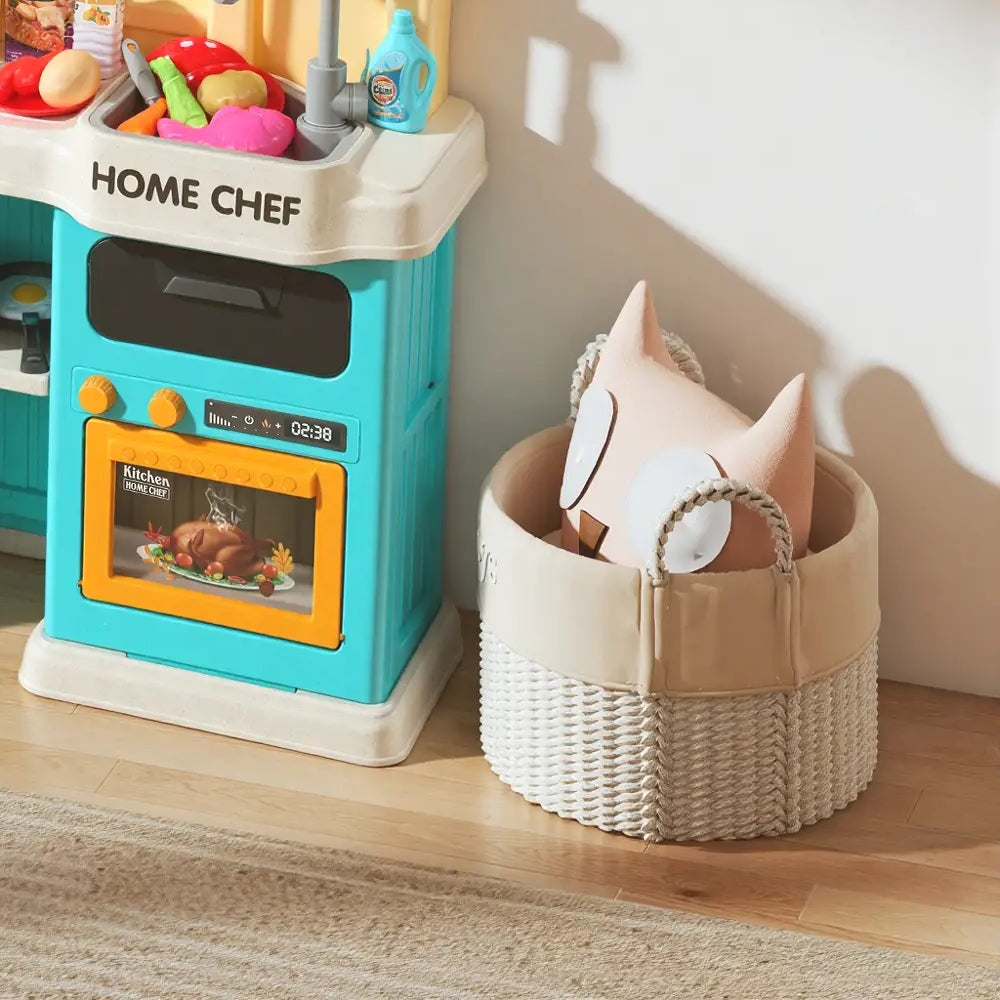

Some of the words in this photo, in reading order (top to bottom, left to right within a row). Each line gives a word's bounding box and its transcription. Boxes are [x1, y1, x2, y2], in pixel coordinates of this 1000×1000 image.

[91, 160, 201, 210] HOME
[211, 184, 302, 226] CHEF
[290, 420, 332, 442] 02:38
[123, 465, 170, 487] Kitchen
[125, 481, 149, 493] HOME
[149, 486, 168, 498] CHEF
